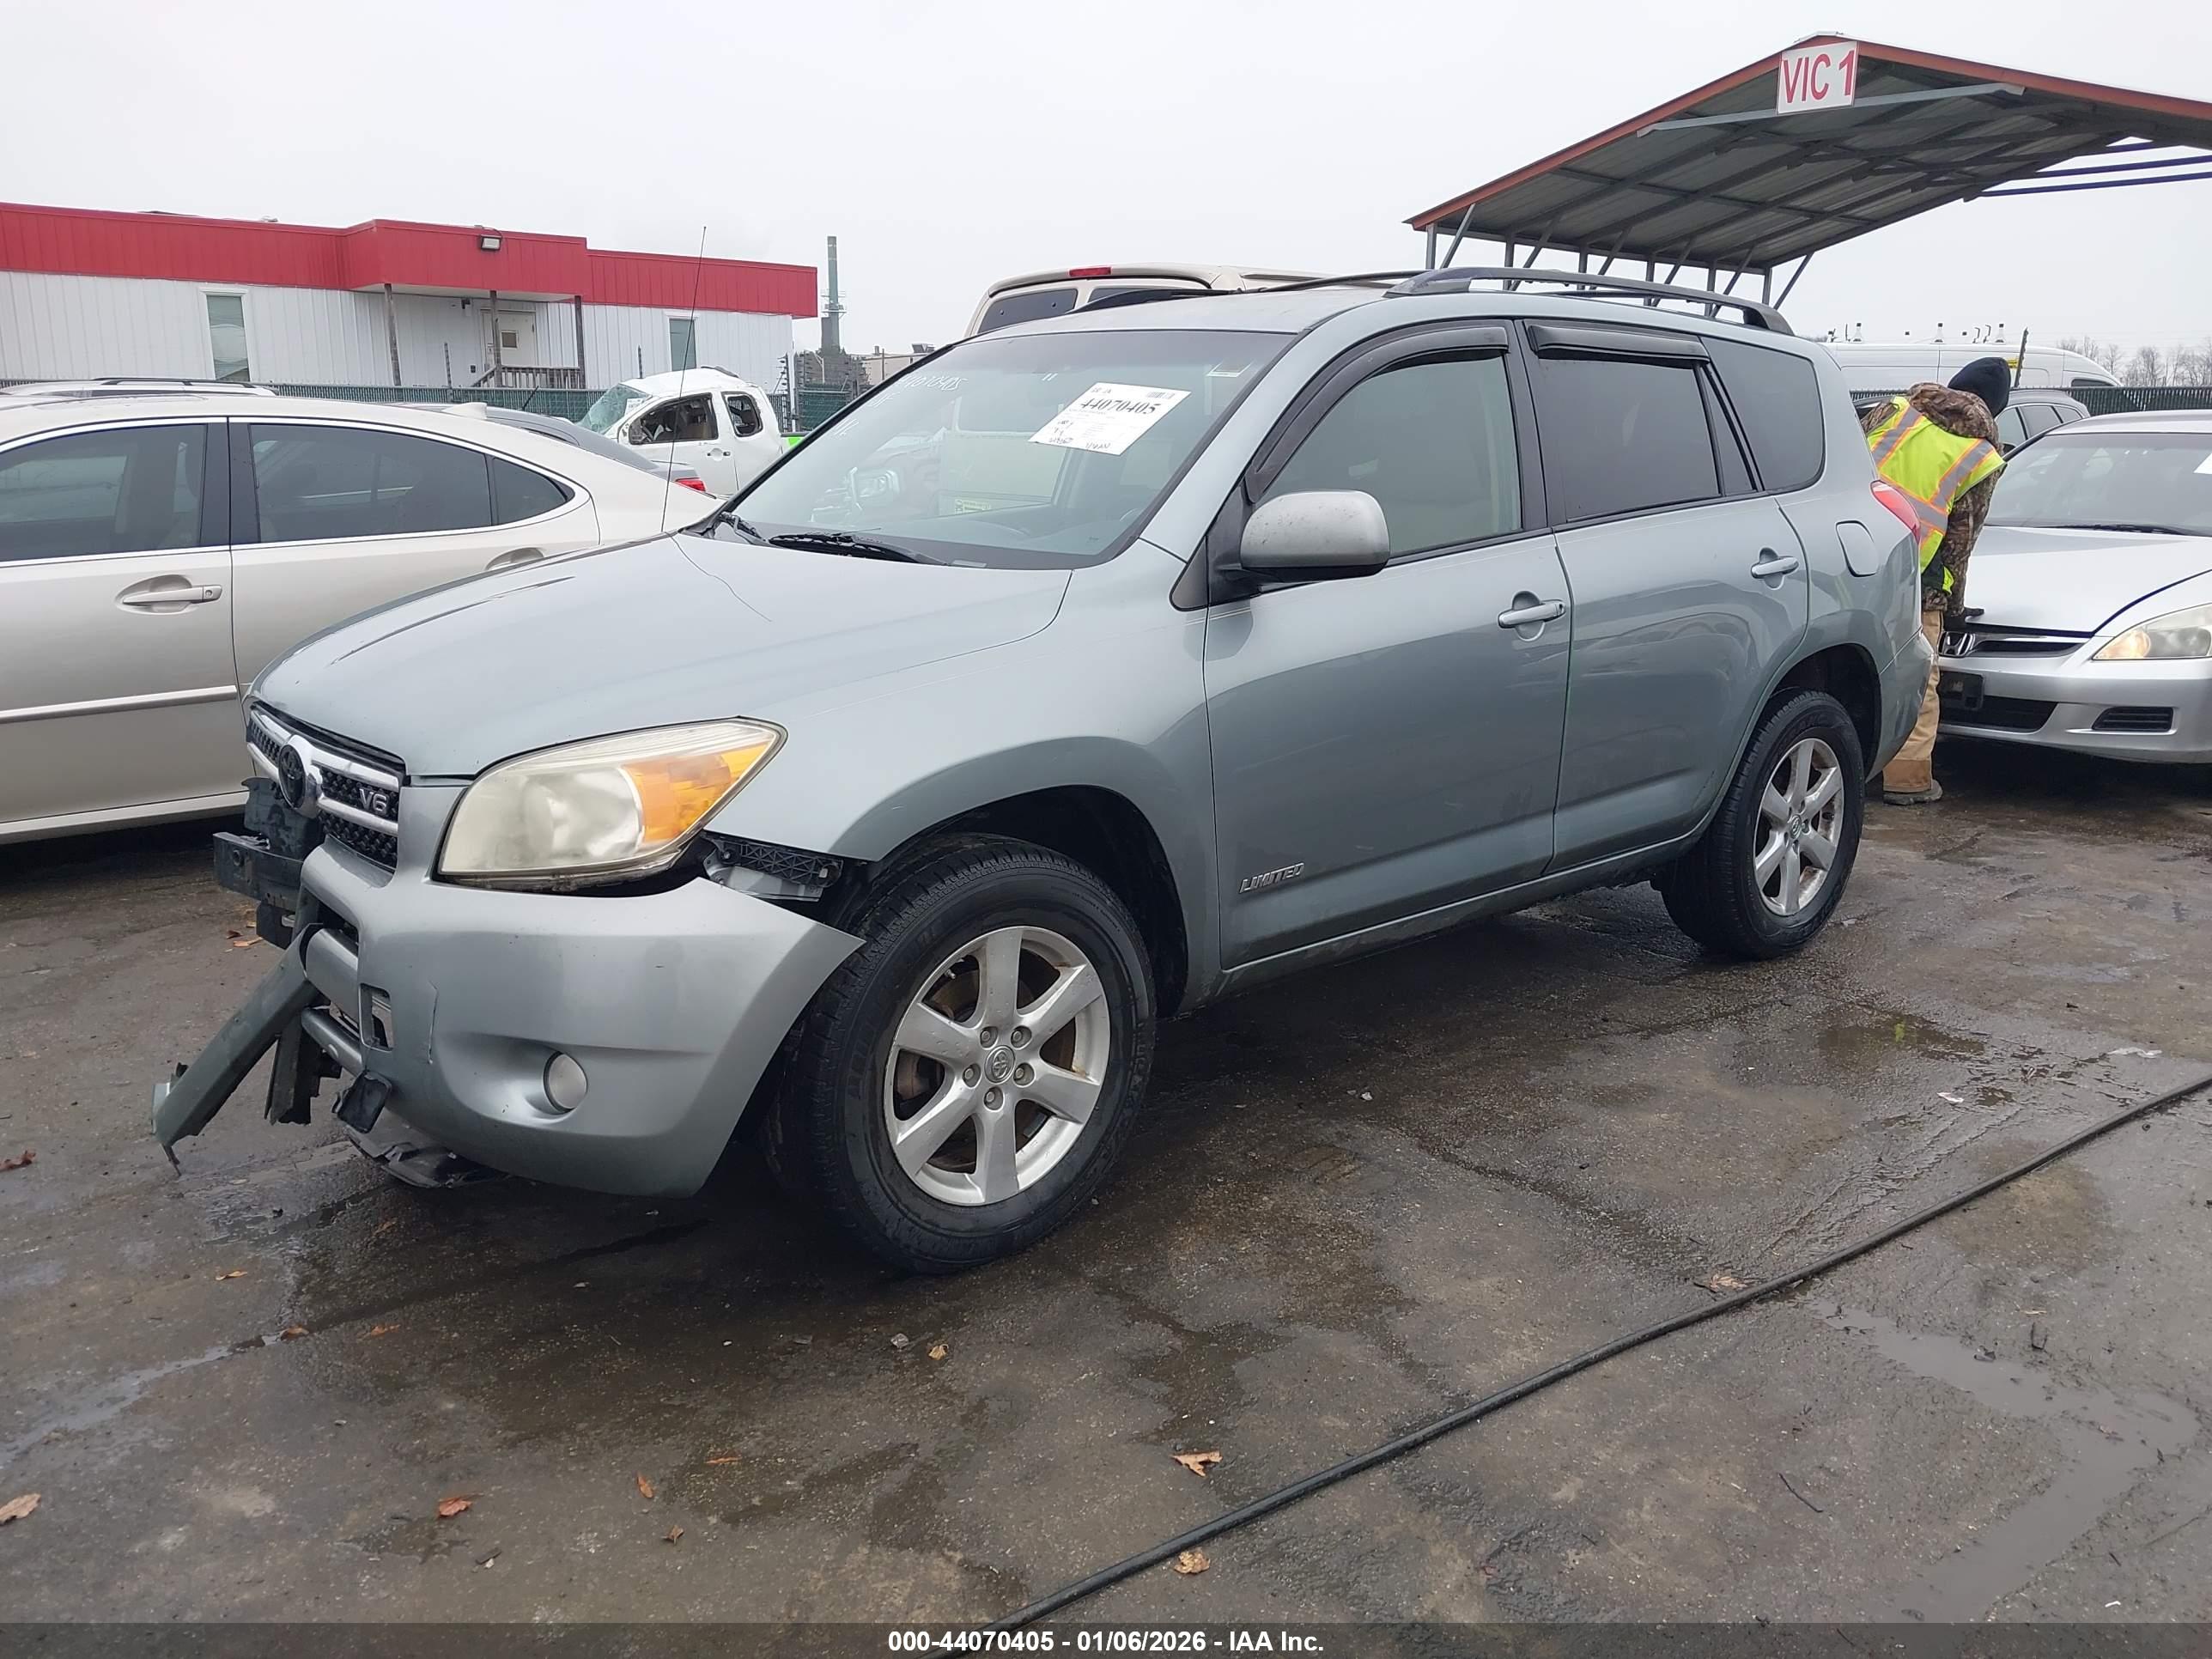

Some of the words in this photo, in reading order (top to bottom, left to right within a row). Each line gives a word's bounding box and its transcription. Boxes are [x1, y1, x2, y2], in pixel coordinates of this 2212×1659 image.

[1784, 54, 1830, 103] VIC
[1839, 50, 1855, 95] 1
[1080, 398, 1163, 415] 44070405
[359, 788, 387, 813] V6
[1239, 862, 1304, 893] LIMITED
